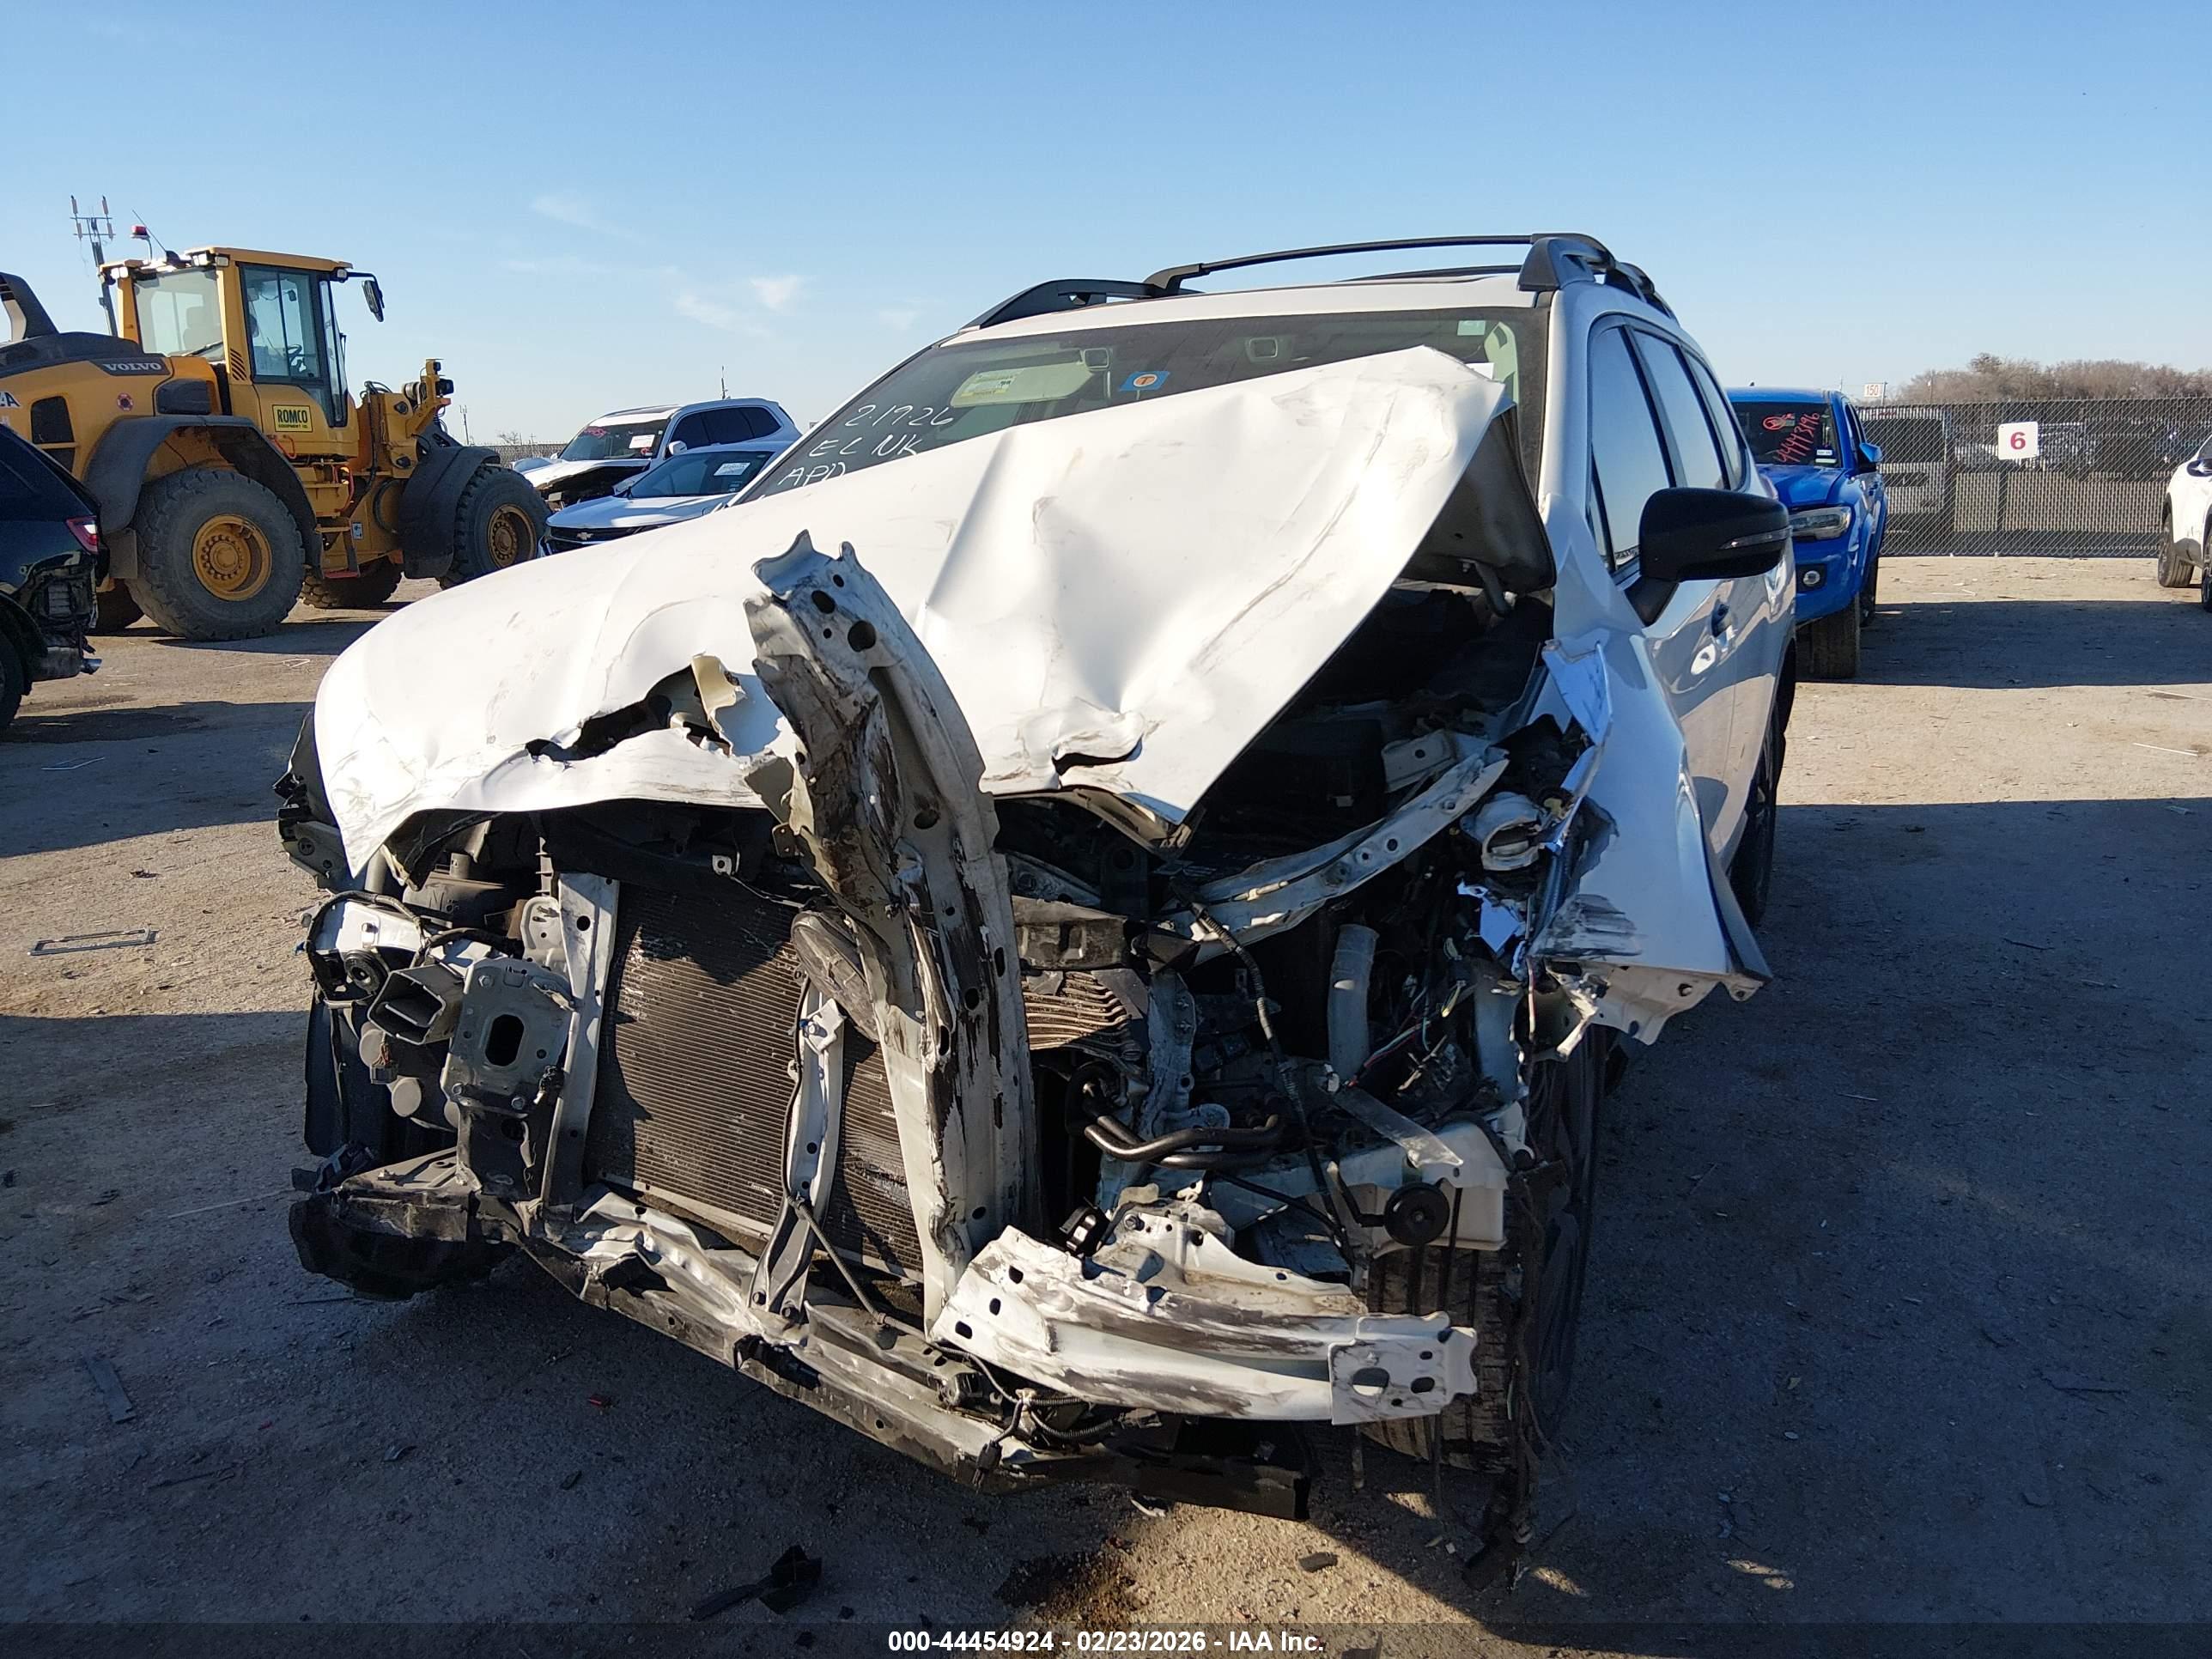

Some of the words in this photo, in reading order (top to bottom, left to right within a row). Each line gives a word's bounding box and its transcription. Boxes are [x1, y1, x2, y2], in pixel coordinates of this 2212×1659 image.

[102, 362, 161, 371] VOLVO
[1866, 384, 1879, 396] 150
[276, 409, 308, 423] ROMCO
[2010, 431, 2026, 450] 6
